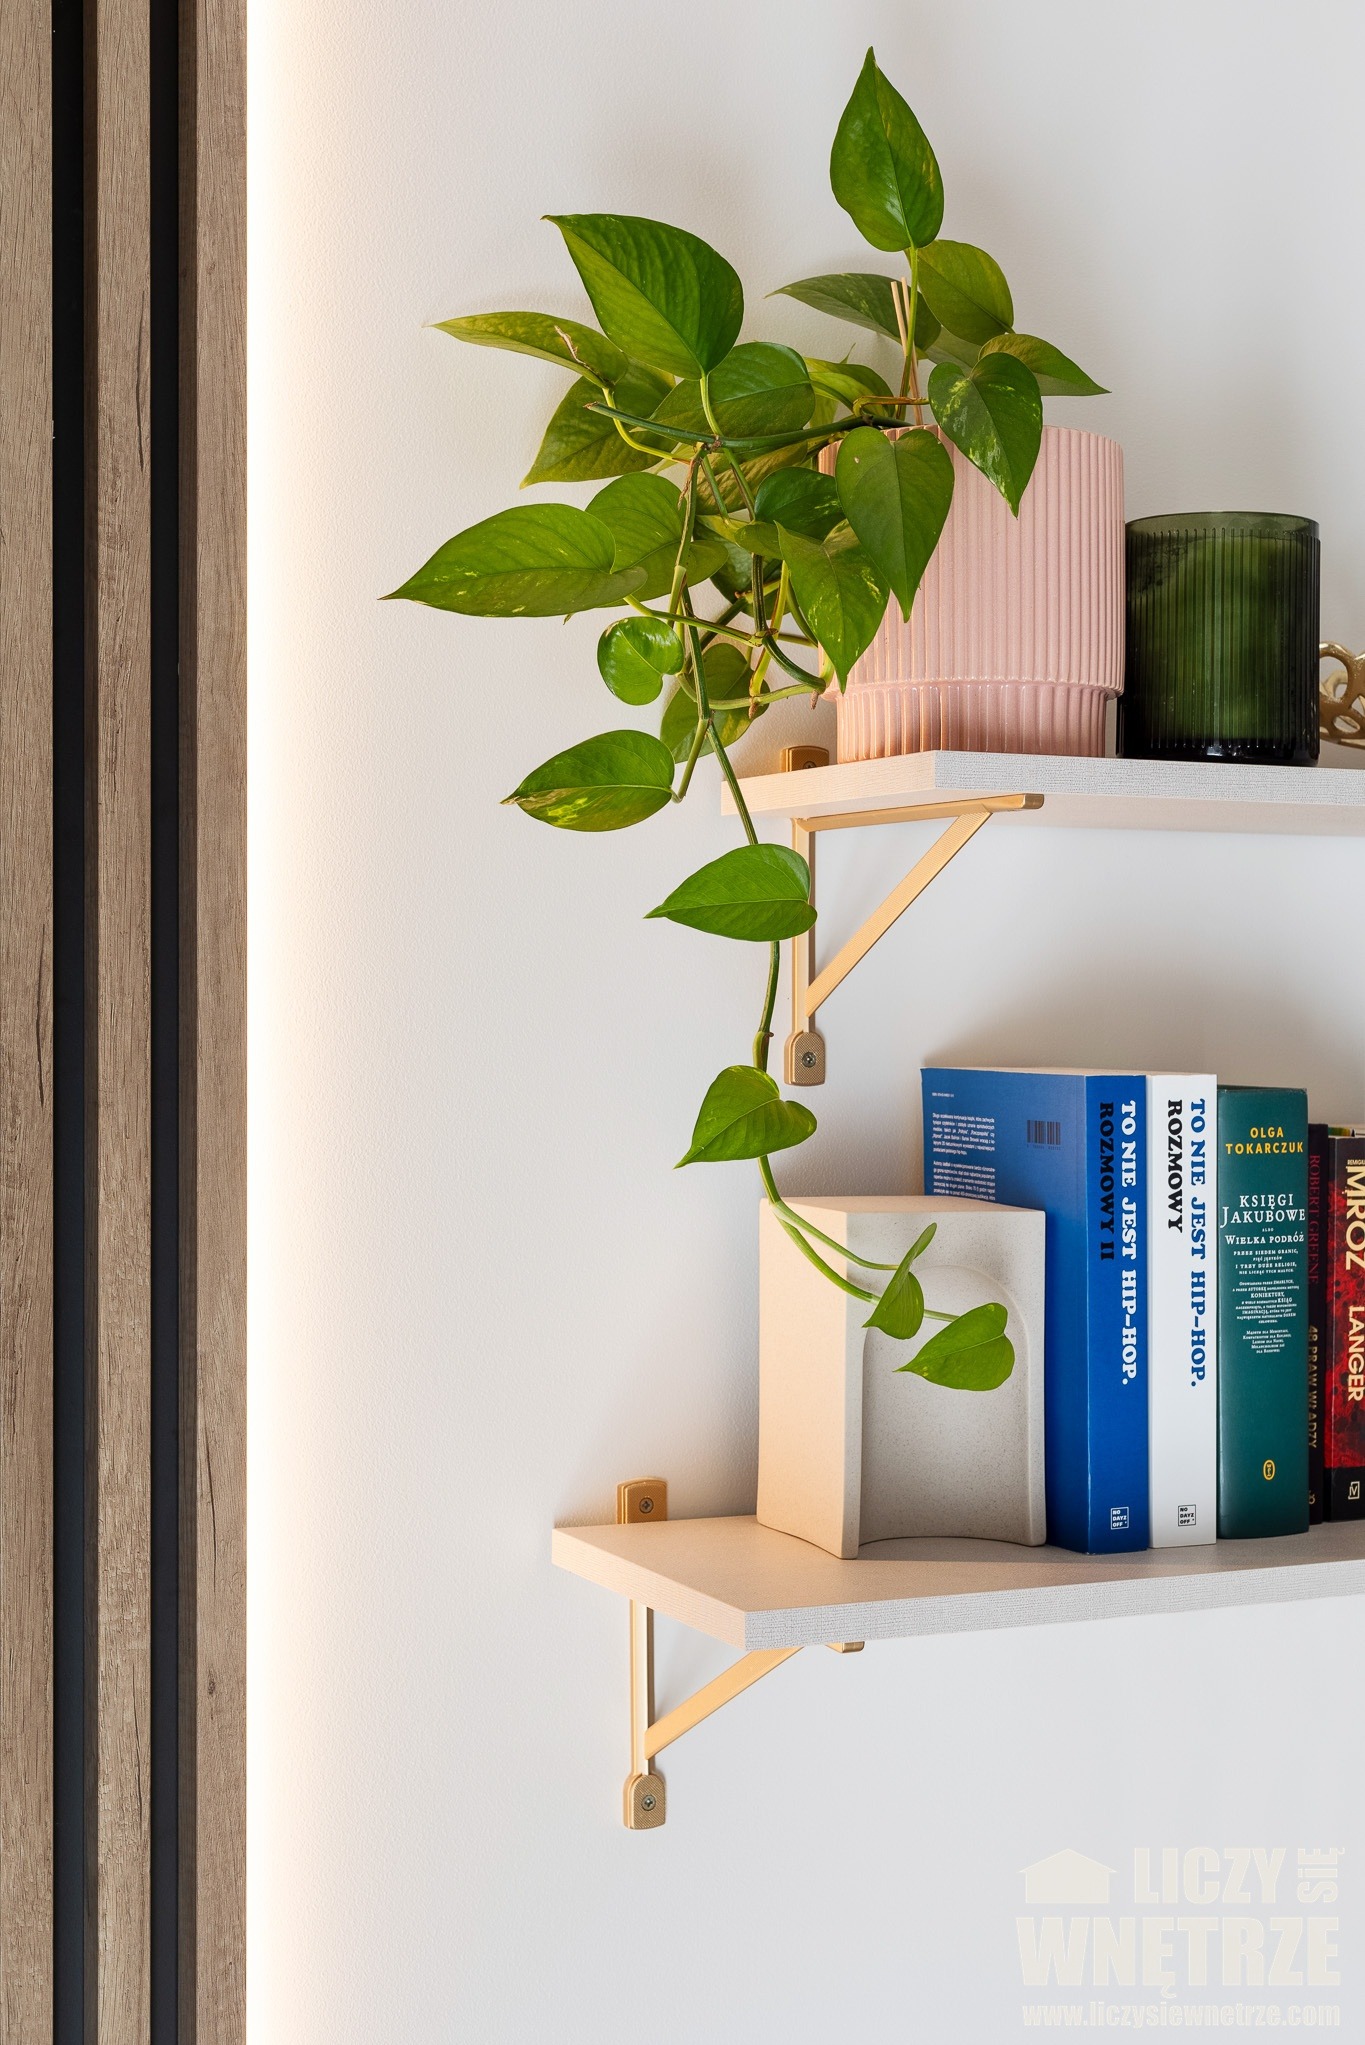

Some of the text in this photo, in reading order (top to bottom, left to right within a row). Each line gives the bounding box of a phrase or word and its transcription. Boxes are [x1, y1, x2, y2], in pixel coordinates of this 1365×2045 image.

[1225, 1141, 1304, 1155] TOKARCZUK
[1250, 1126, 1284, 1139] OLGA
[1100, 1102, 1115, 1261] ROZMOWY II
[1168, 1099, 1183, 1233] ROZMOWY
[1308, 1155, 1321, 1215] ROBERT
[1219, 1206, 1306, 1229] JAKUBOWE
[1239, 1193, 1294, 1210] KSIĘGI
[1121, 1100, 1137, 1385] TO NIE JEST HIP-HOP.
[1190, 1098, 1206, 1387] TO NIE JEST HIP-HOP.
[1224, 1231, 1305, 1245] WIELKA PODRÓŻ
[1308, 1325, 1319, 1342] 48
[1347, 1305, 1365, 1402] LANGER
